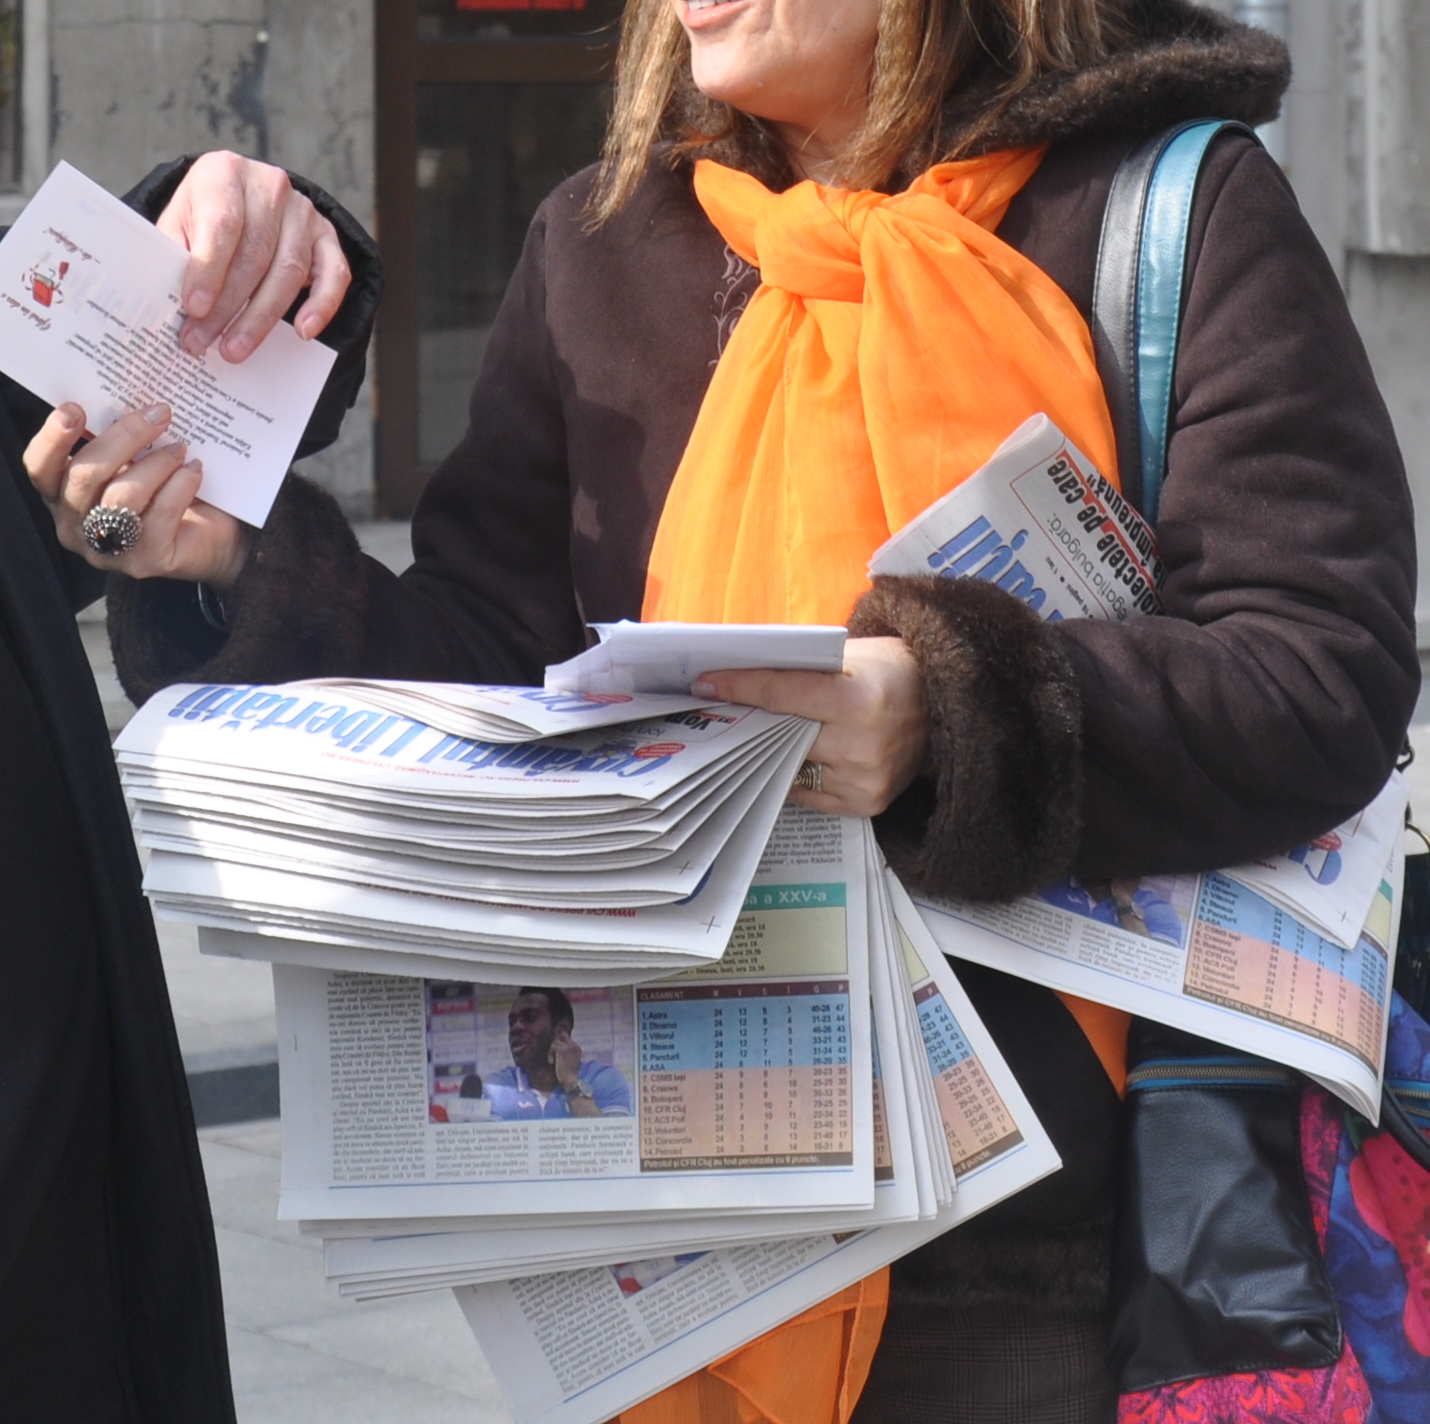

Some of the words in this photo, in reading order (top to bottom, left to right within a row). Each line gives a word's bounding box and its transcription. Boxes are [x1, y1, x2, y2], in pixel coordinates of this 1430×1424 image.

[1047, 459, 1085, 505] care
[1076, 504, 1110, 534] pe
[1045, 512, 1093, 577] bulgară:
[779, 890, 827, 903] XXV-a
